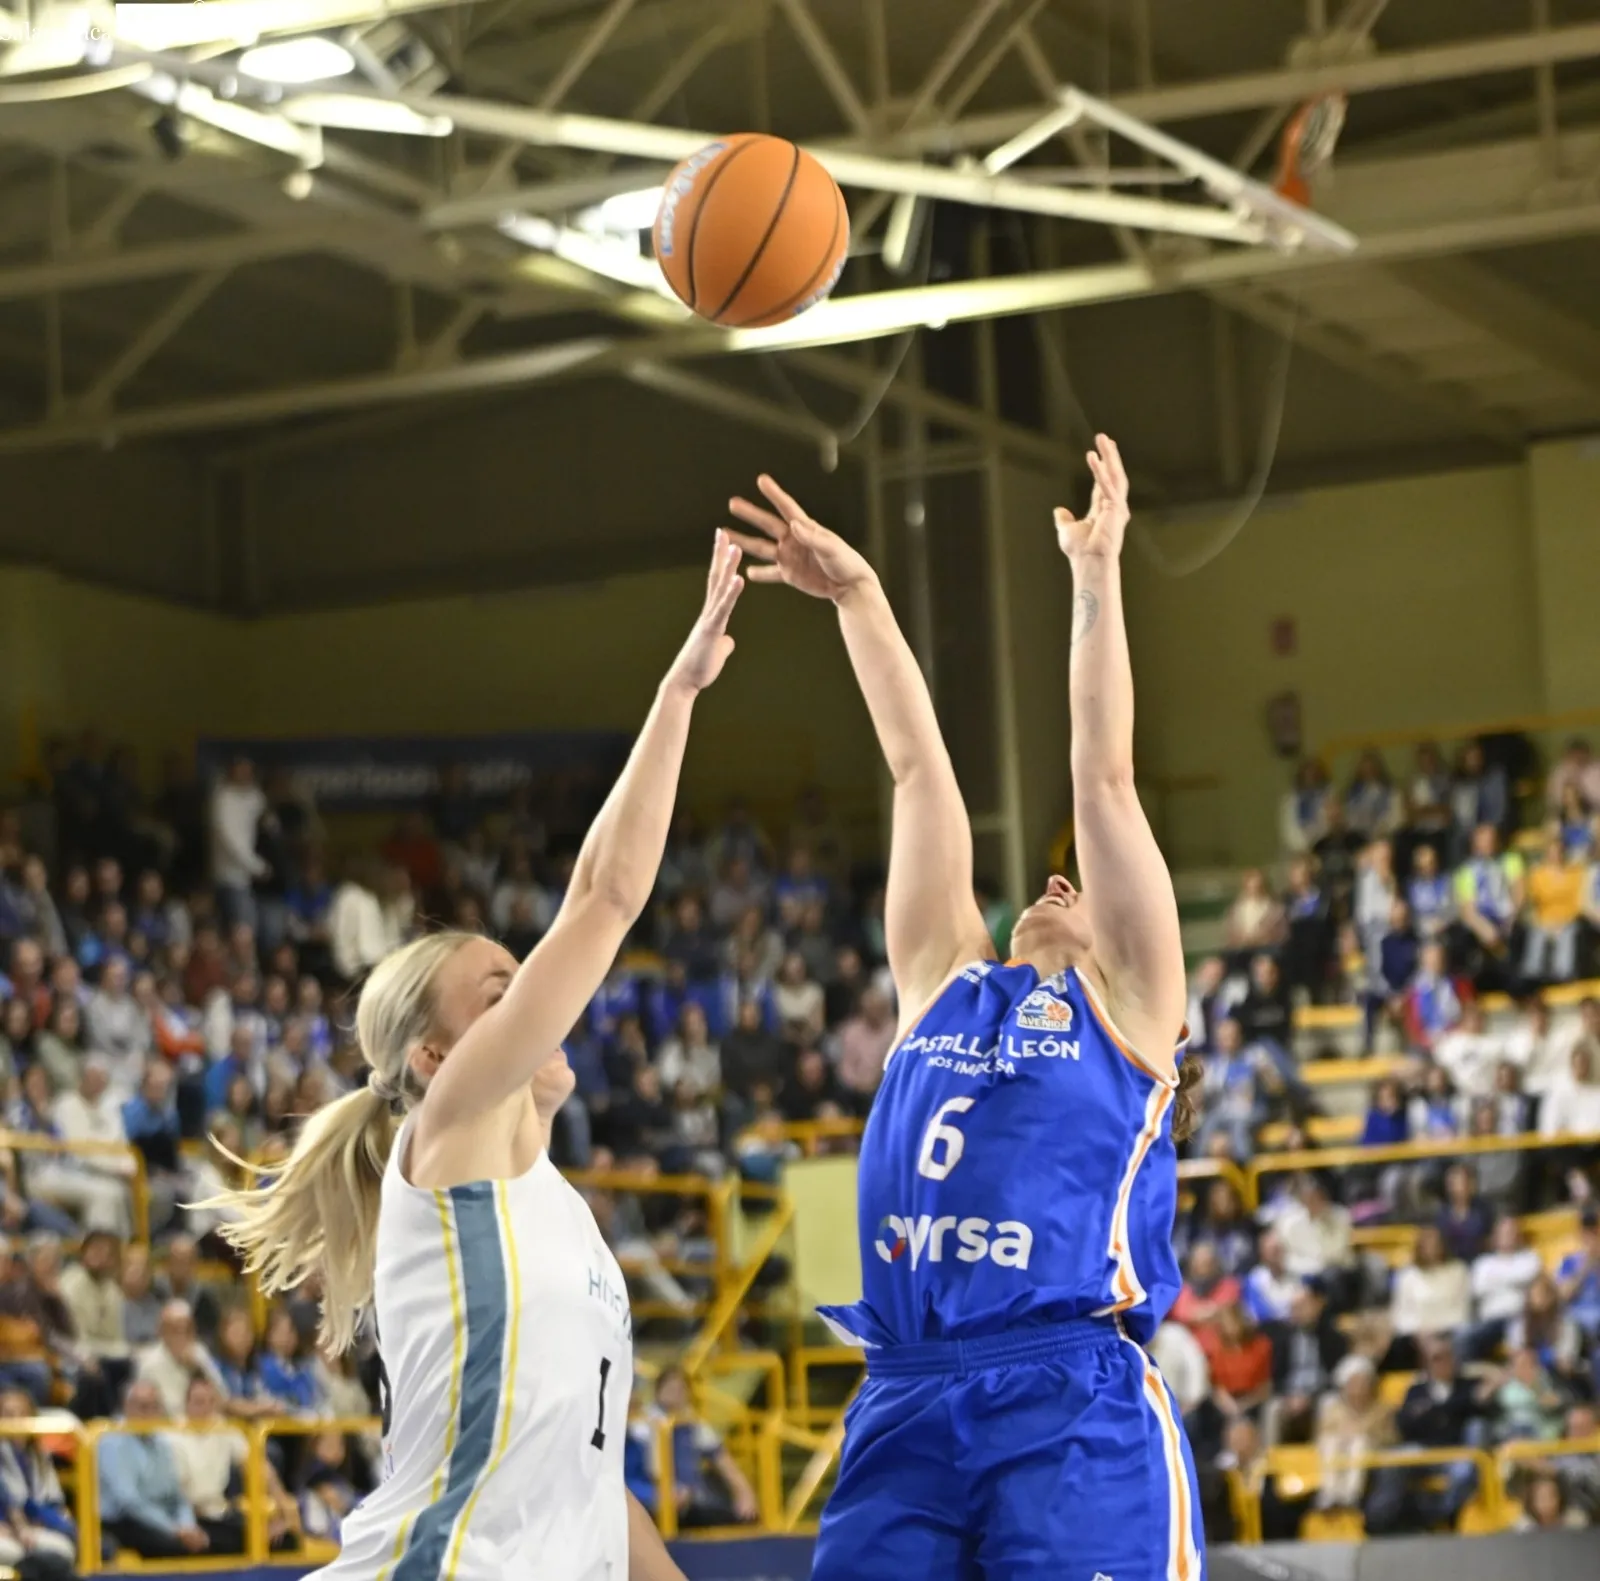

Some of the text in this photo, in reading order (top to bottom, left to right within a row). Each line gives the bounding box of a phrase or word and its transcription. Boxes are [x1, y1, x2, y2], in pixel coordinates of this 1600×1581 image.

[1007, 1033, 1080, 1061] LEÓN
[926, 1056, 953, 1069] NOS
[917, 1096, 976, 1181] 6
